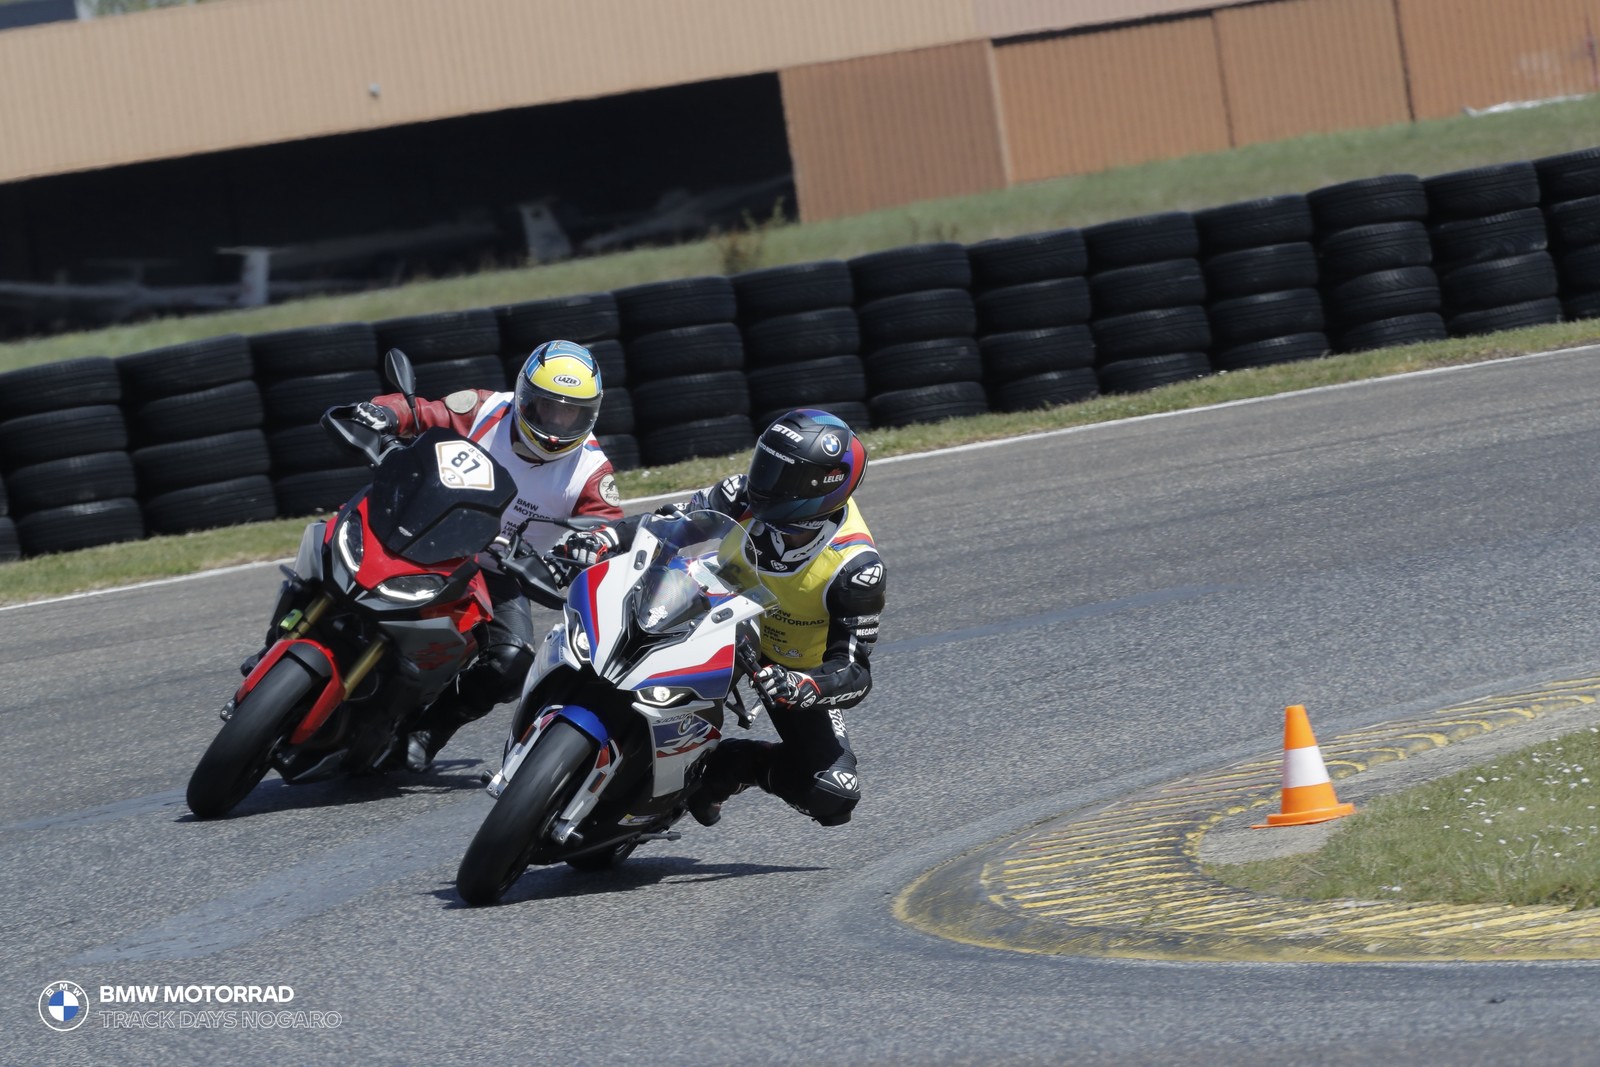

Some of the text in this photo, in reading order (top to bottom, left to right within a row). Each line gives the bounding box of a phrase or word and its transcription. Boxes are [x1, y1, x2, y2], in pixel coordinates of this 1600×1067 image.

[558, 376, 578, 385] LAZER
[771, 424, 804, 443] STM
[451, 451, 481, 475] 87
[775, 452, 795, 465] RACING
[448, 474, 456, 482] 2
[823, 473, 845, 484] LELEU
[516, 498, 539, 511] BMW
[817, 686, 868, 705] IXON
